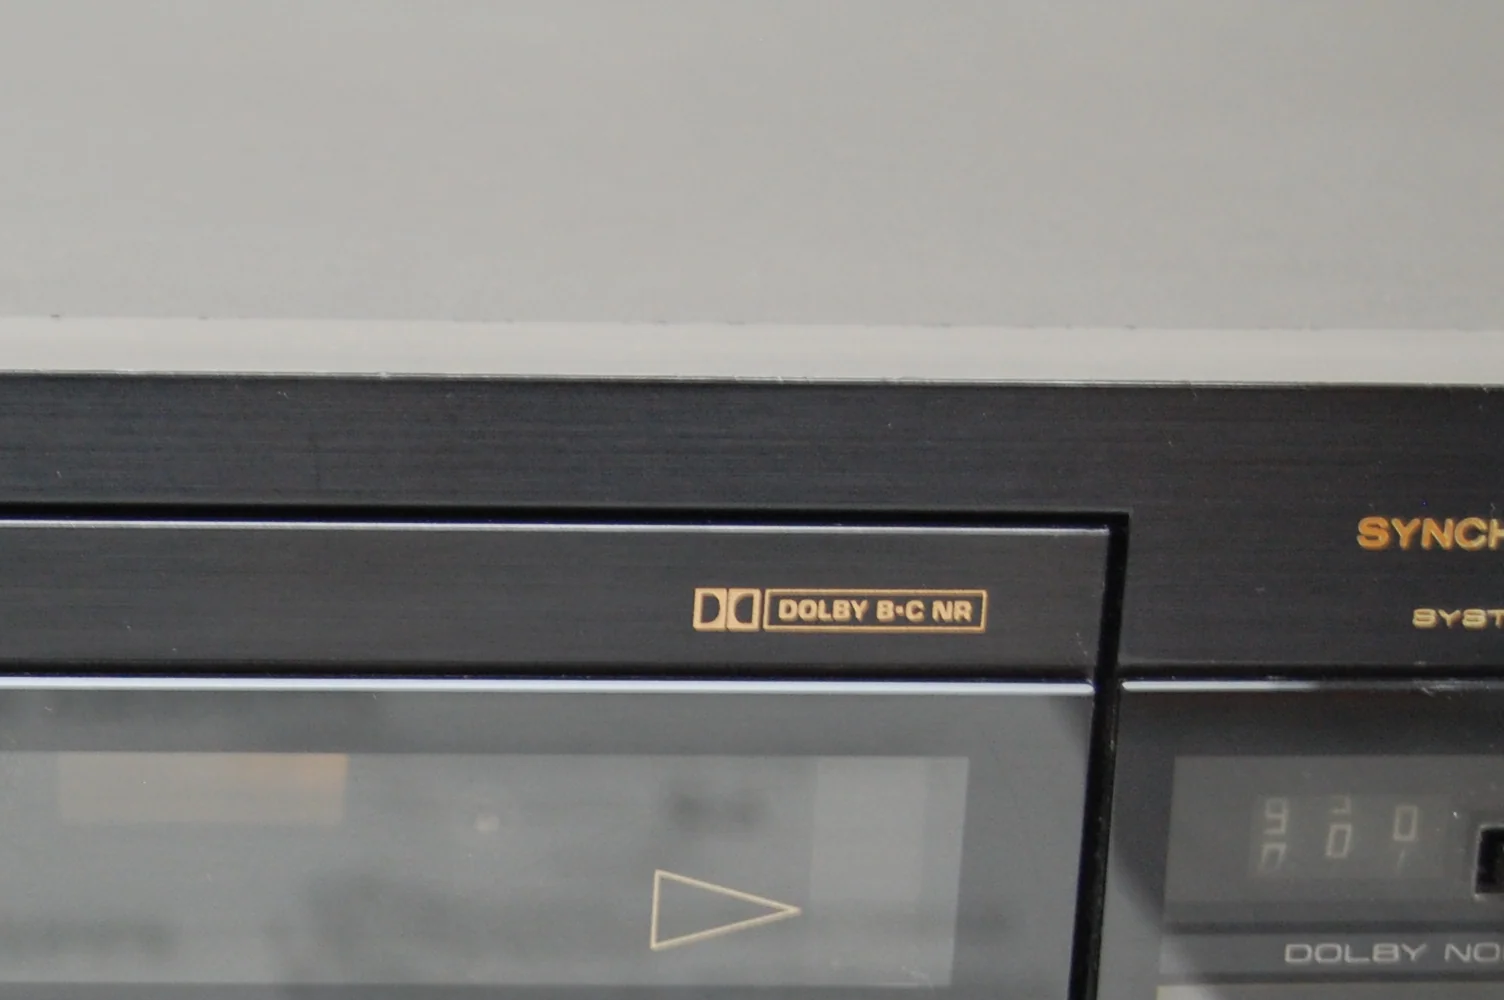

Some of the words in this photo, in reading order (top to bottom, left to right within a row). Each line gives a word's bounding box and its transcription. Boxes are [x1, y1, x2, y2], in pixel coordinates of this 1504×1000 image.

[778, 598, 869, 622] DOLBY
[932, 600, 973, 622] NR
[1284, 942, 1428, 965] DOLBY
[1444, 942, 1504, 963] NO
